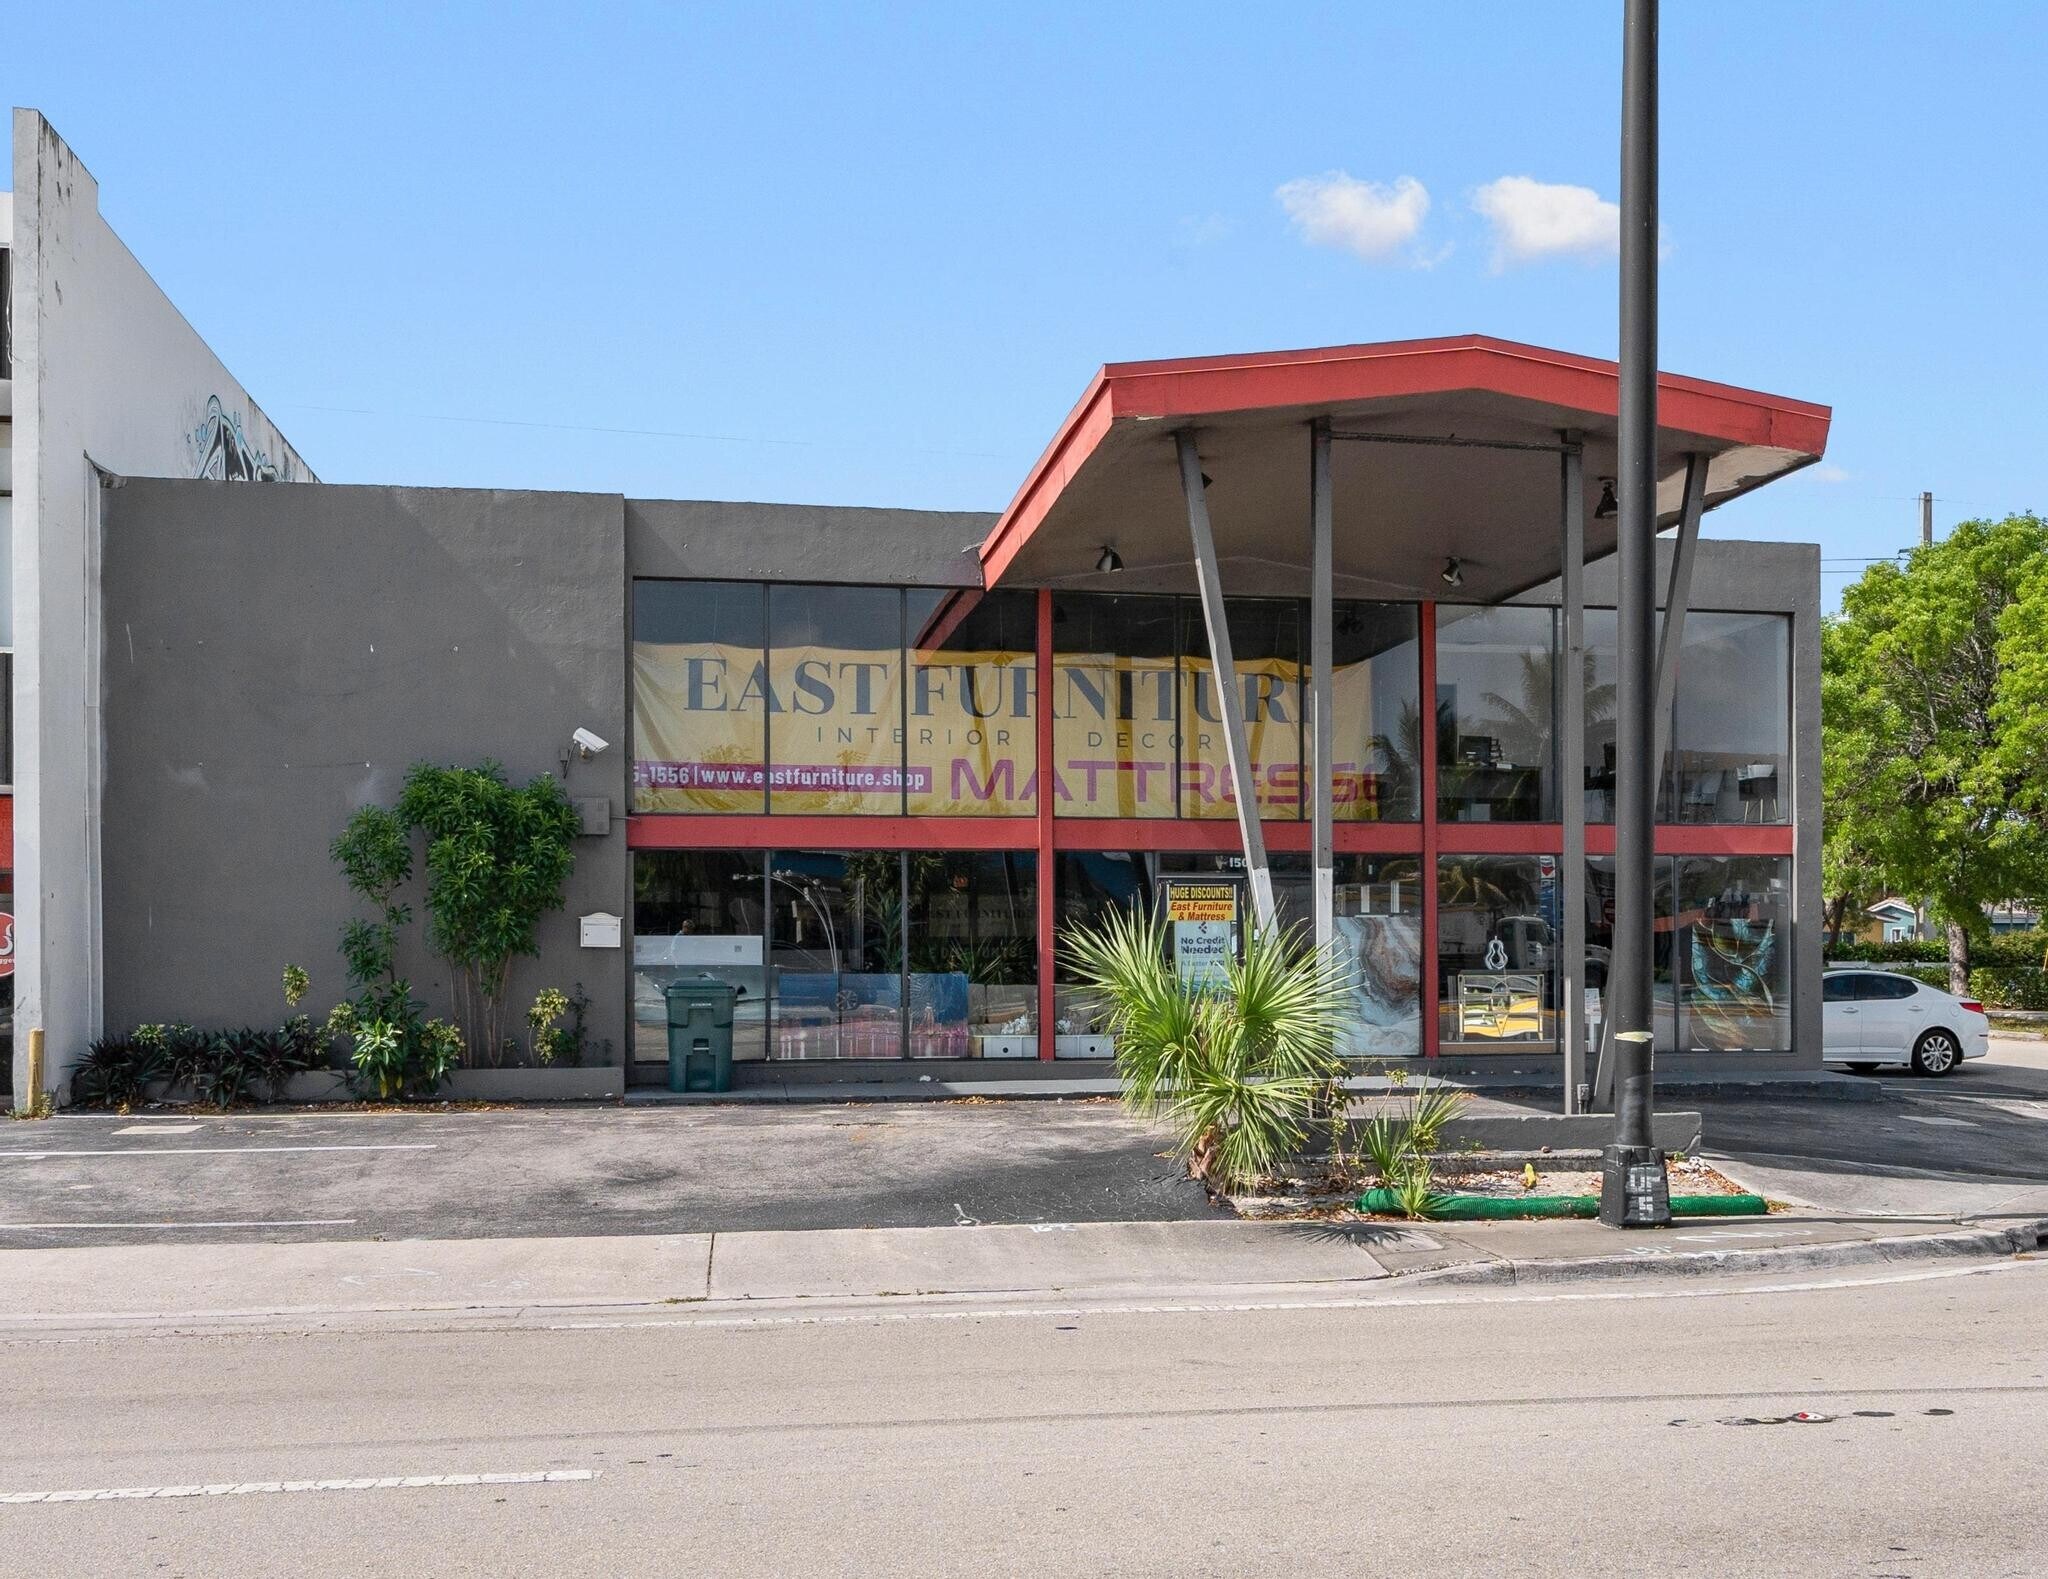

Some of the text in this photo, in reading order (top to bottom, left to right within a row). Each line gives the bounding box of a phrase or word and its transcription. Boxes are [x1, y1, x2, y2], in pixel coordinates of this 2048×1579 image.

[683, 657, 888, 715] EAST
[817, 726, 1212, 750] INTERIOR DECOR
[1170, 886, 1233, 899] HUGE DISCOUNTS!!
[1170, 901, 1233, 911] East Furniture
[1178, 911, 1226, 921] & Mattress
[1181, 936, 1226, 945] No Credit
